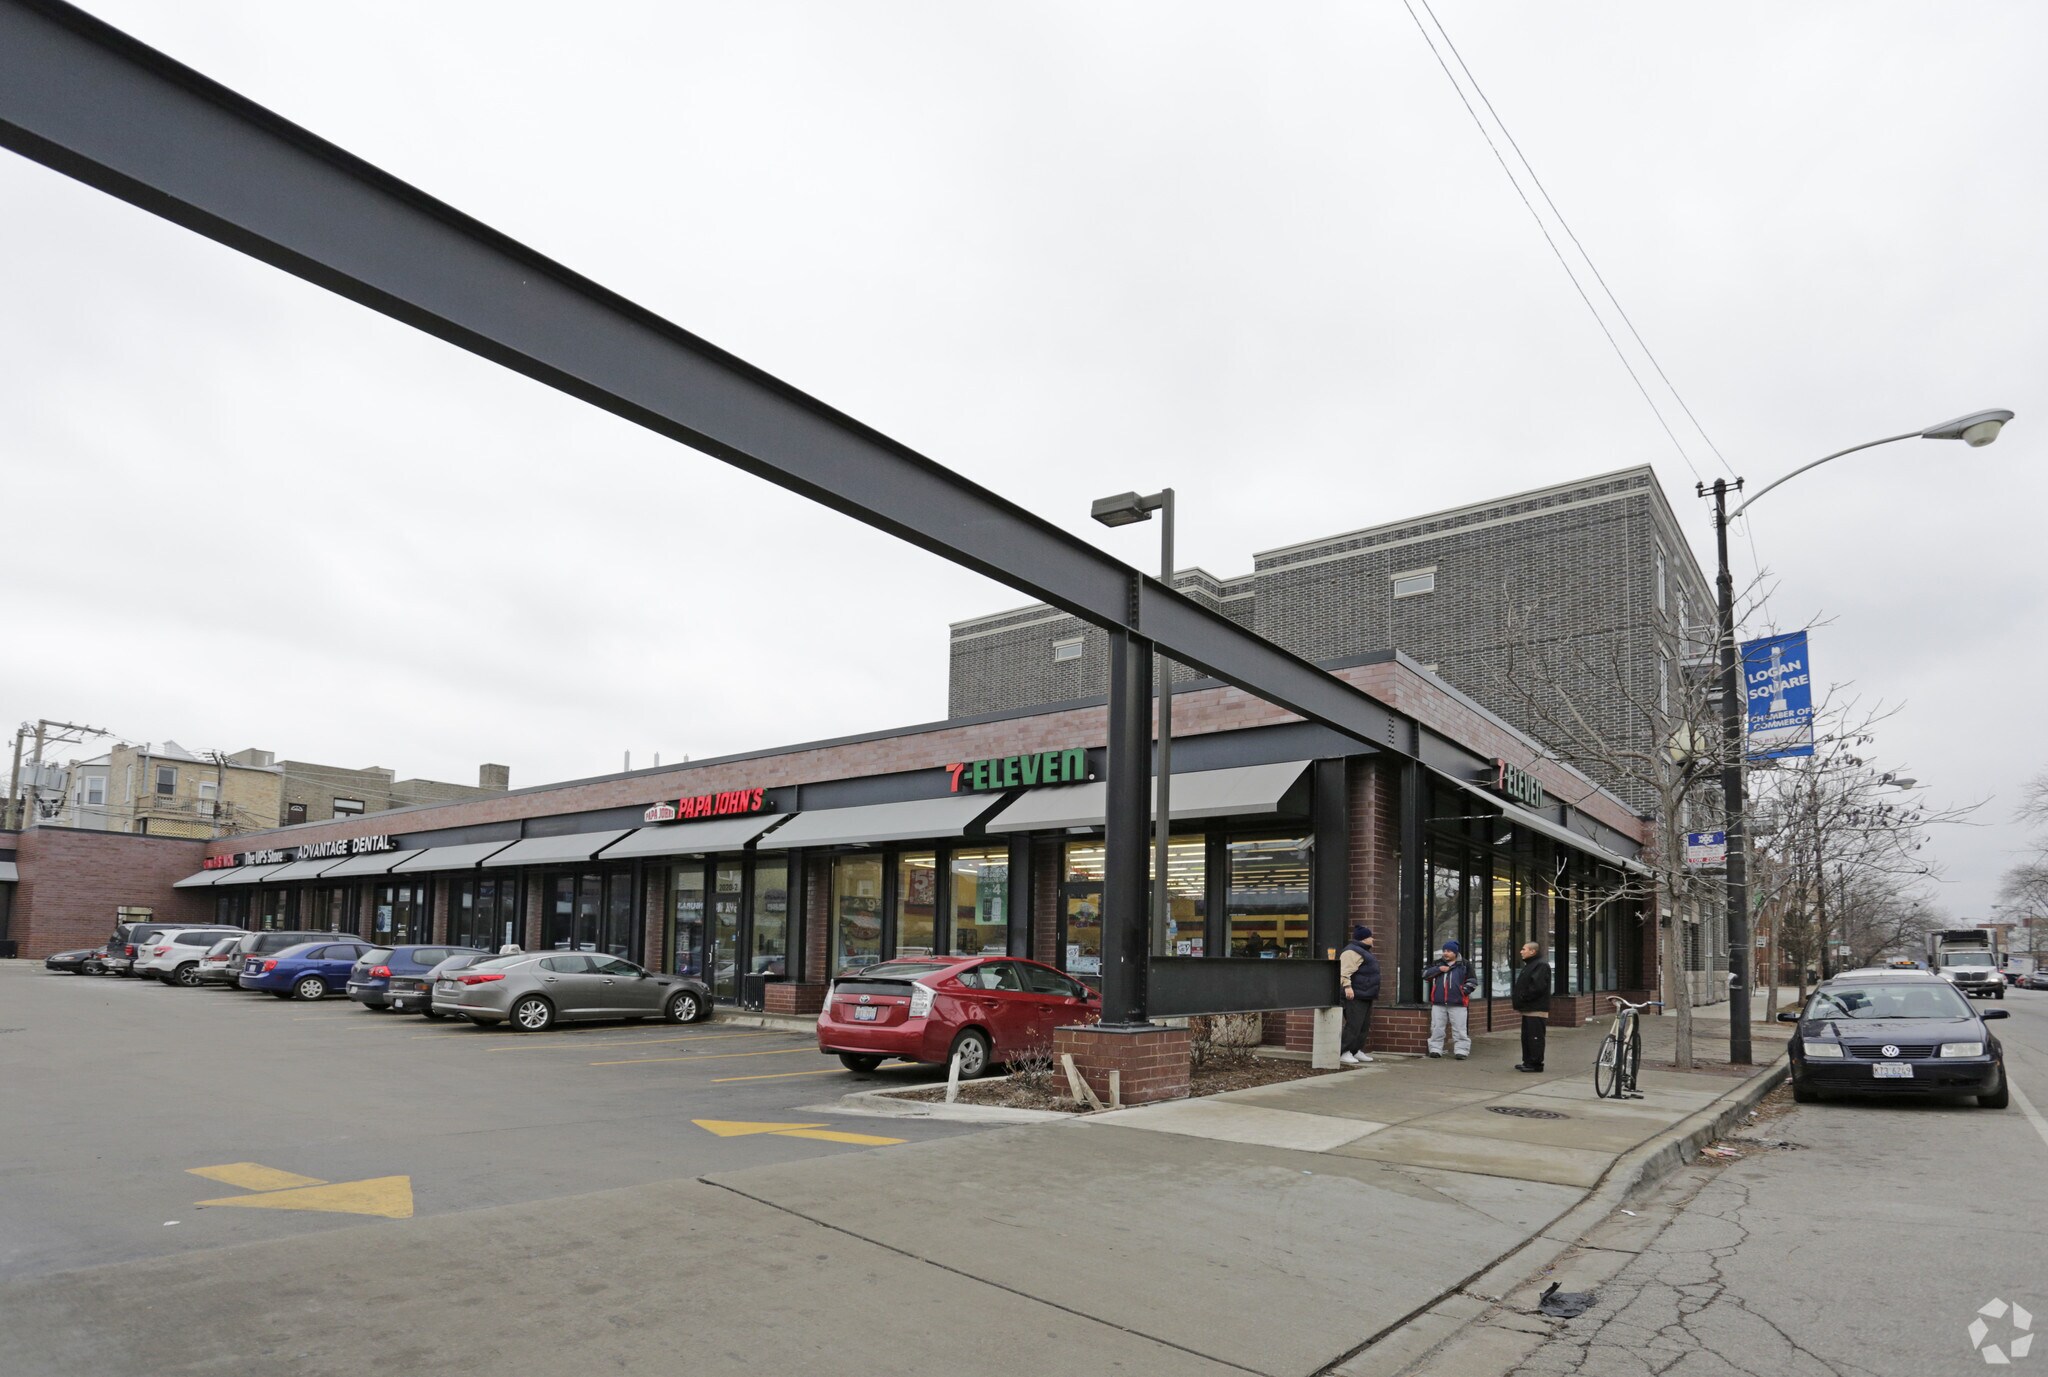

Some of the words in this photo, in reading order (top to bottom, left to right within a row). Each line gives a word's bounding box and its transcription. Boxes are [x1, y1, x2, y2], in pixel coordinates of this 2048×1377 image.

[1748, 660, 1801, 684] LOGAN
[1749, 674, 1809, 699] SQUARE
[1797, 707, 1810, 716] OF
[676, 795, 713, 819] PAPA
[713, 788, 764, 815] JOHN'S
[245, 852, 256, 865] The
[255, 850, 268, 864] UPS
[268, 849, 283, 863] Store
[297, 840, 348, 859] ADVANTAGE
[352, 834, 390, 853] DENTAL
